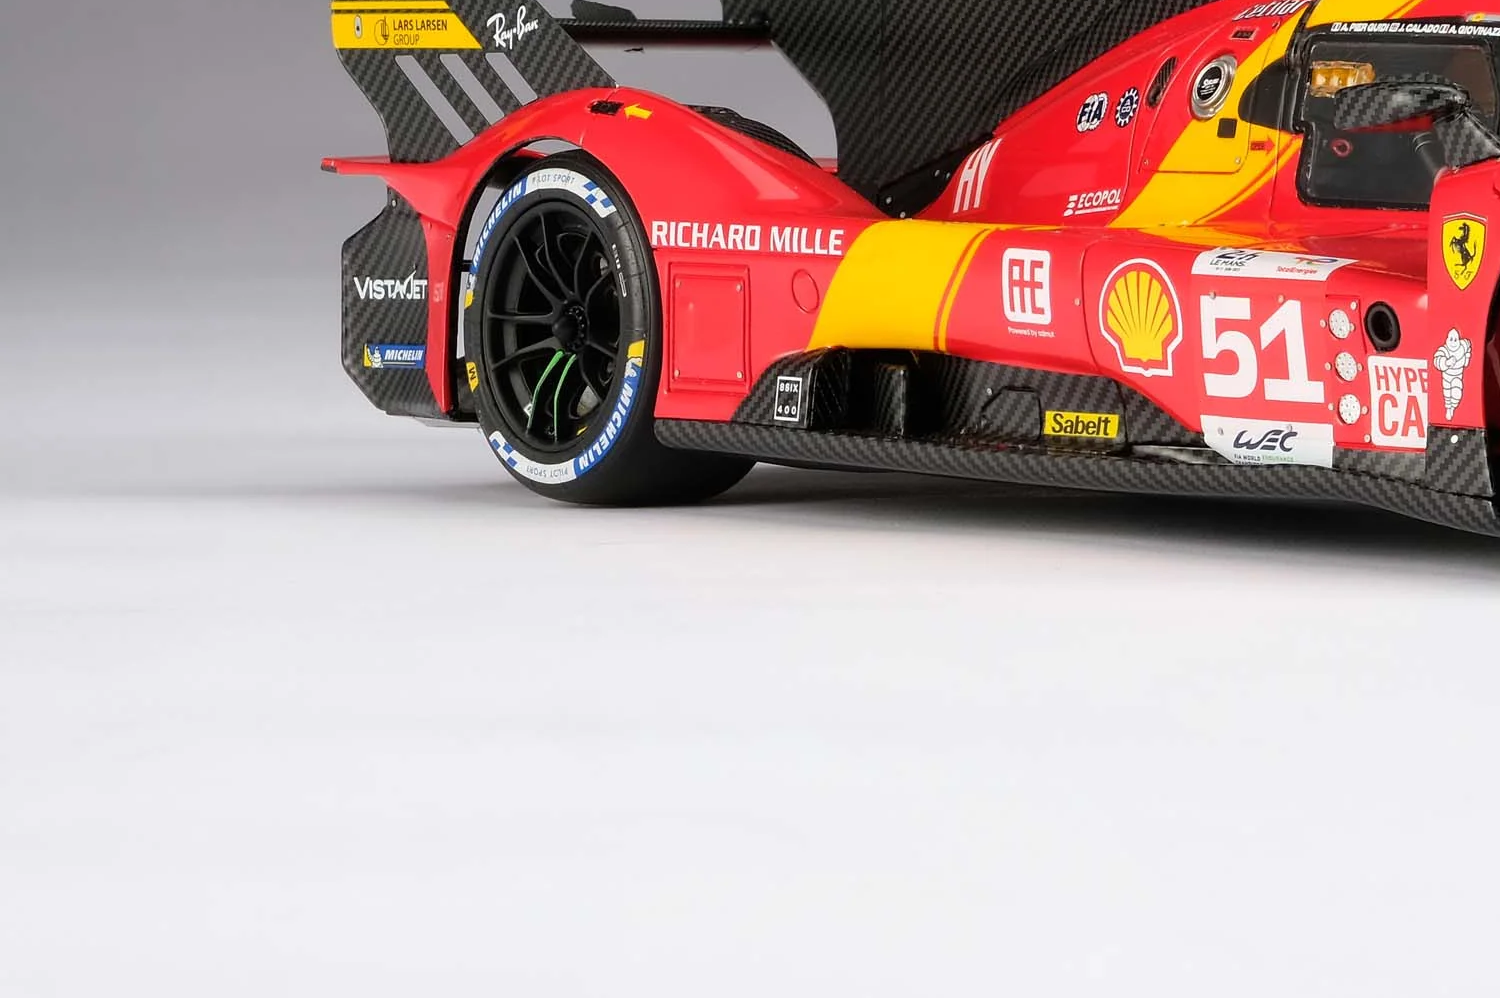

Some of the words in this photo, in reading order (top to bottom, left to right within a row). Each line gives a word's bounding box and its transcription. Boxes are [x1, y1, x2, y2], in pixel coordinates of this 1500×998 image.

[393, 19, 414, 31] LARS
[415, 19, 448, 31] LARSEN
[1405, 24, 1440, 34] CALADO
[393, 33, 420, 46] GROUP
[532, 173, 550, 184] PILOT
[552, 174, 576, 185] SPORT
[953, 137, 1003, 214] HY
[1077, 188, 1121, 209] ECOPOL
[472, 182, 523, 268] MICHELIN
[651, 220, 761, 251] RICHARD
[769, 226, 845, 256] MILLE
[384, 349, 424, 361] MICHELIN
[1200, 294, 1325, 404] 51
[1374, 365, 1429, 393] HYPE
[777, 404, 797, 415] 400
[1378, 393, 1426, 438] CA
[579, 380, 635, 471] MICHELIN
[1050, 412, 1112, 438] Sabelt
[1232, 428, 1298, 452] WEC
[549, 468, 569, 479] PILOT
